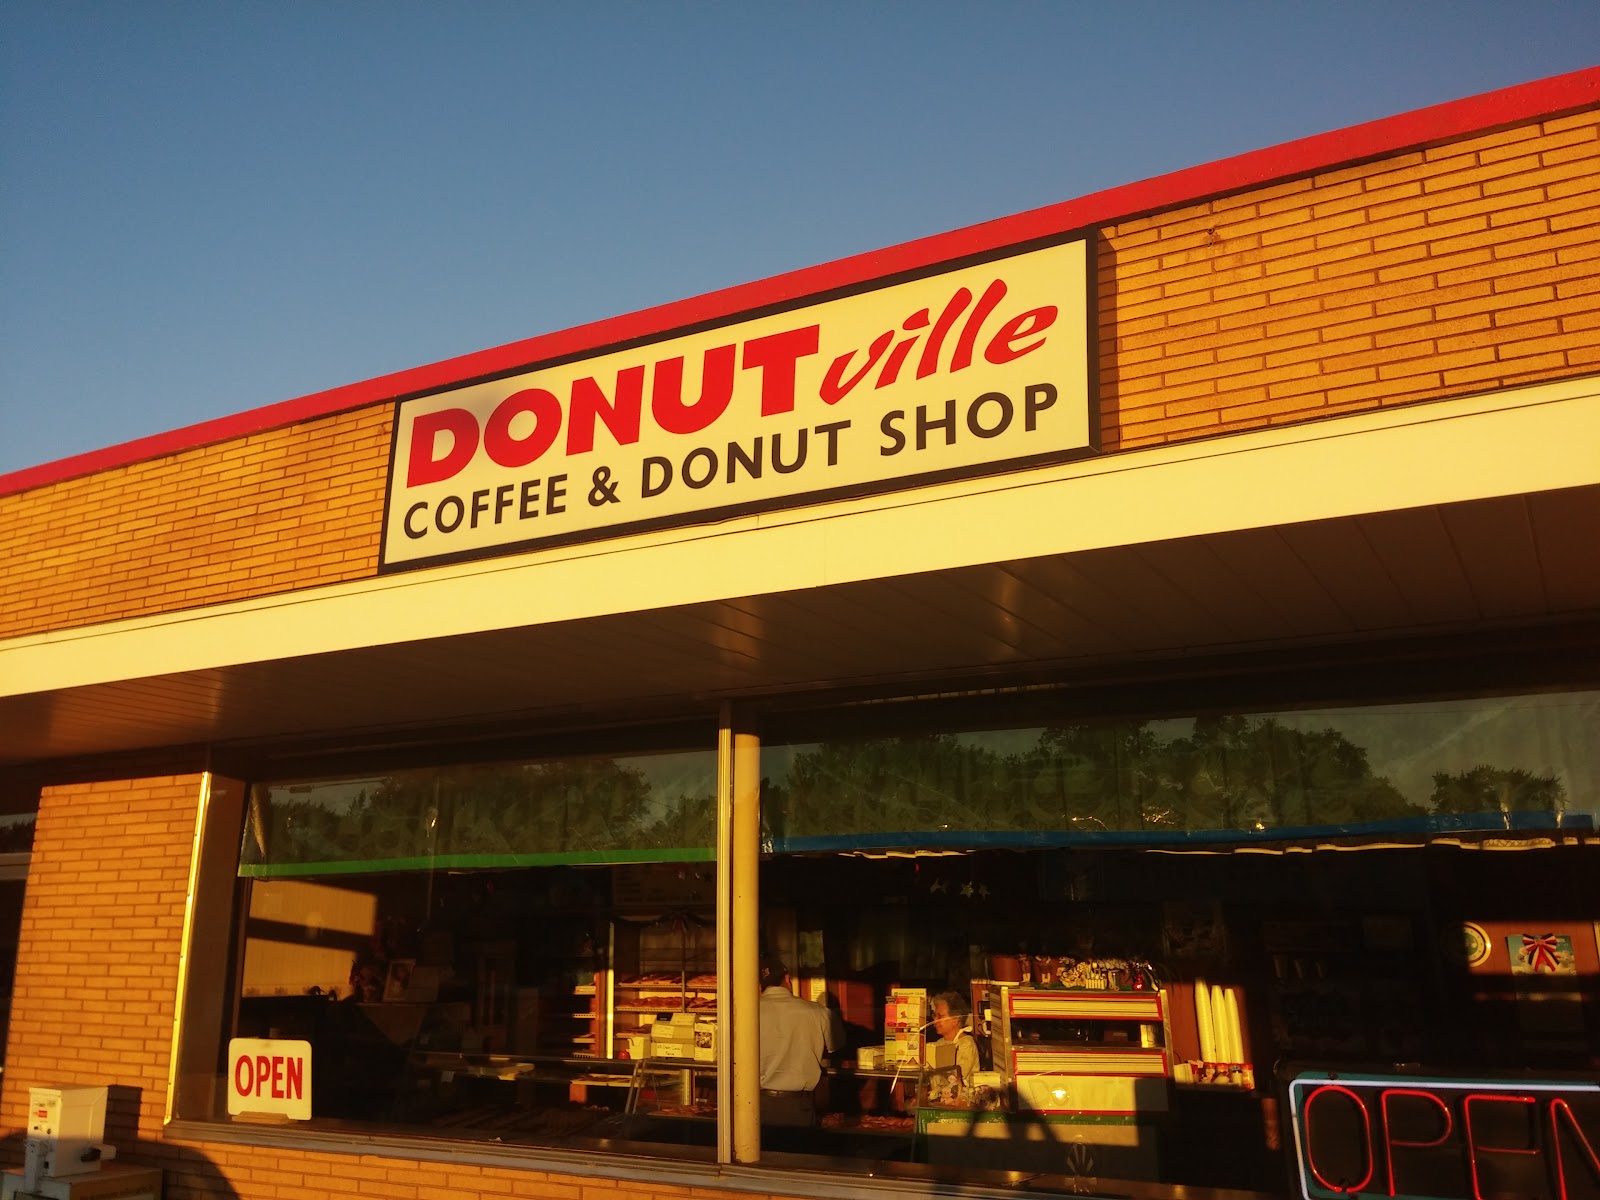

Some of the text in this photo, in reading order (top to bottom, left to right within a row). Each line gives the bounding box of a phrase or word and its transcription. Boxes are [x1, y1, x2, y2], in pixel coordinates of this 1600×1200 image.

[403, 383, 1058, 540] COFFEE & DONUT SHOP
[235, 1055, 303, 1099] OPEN
